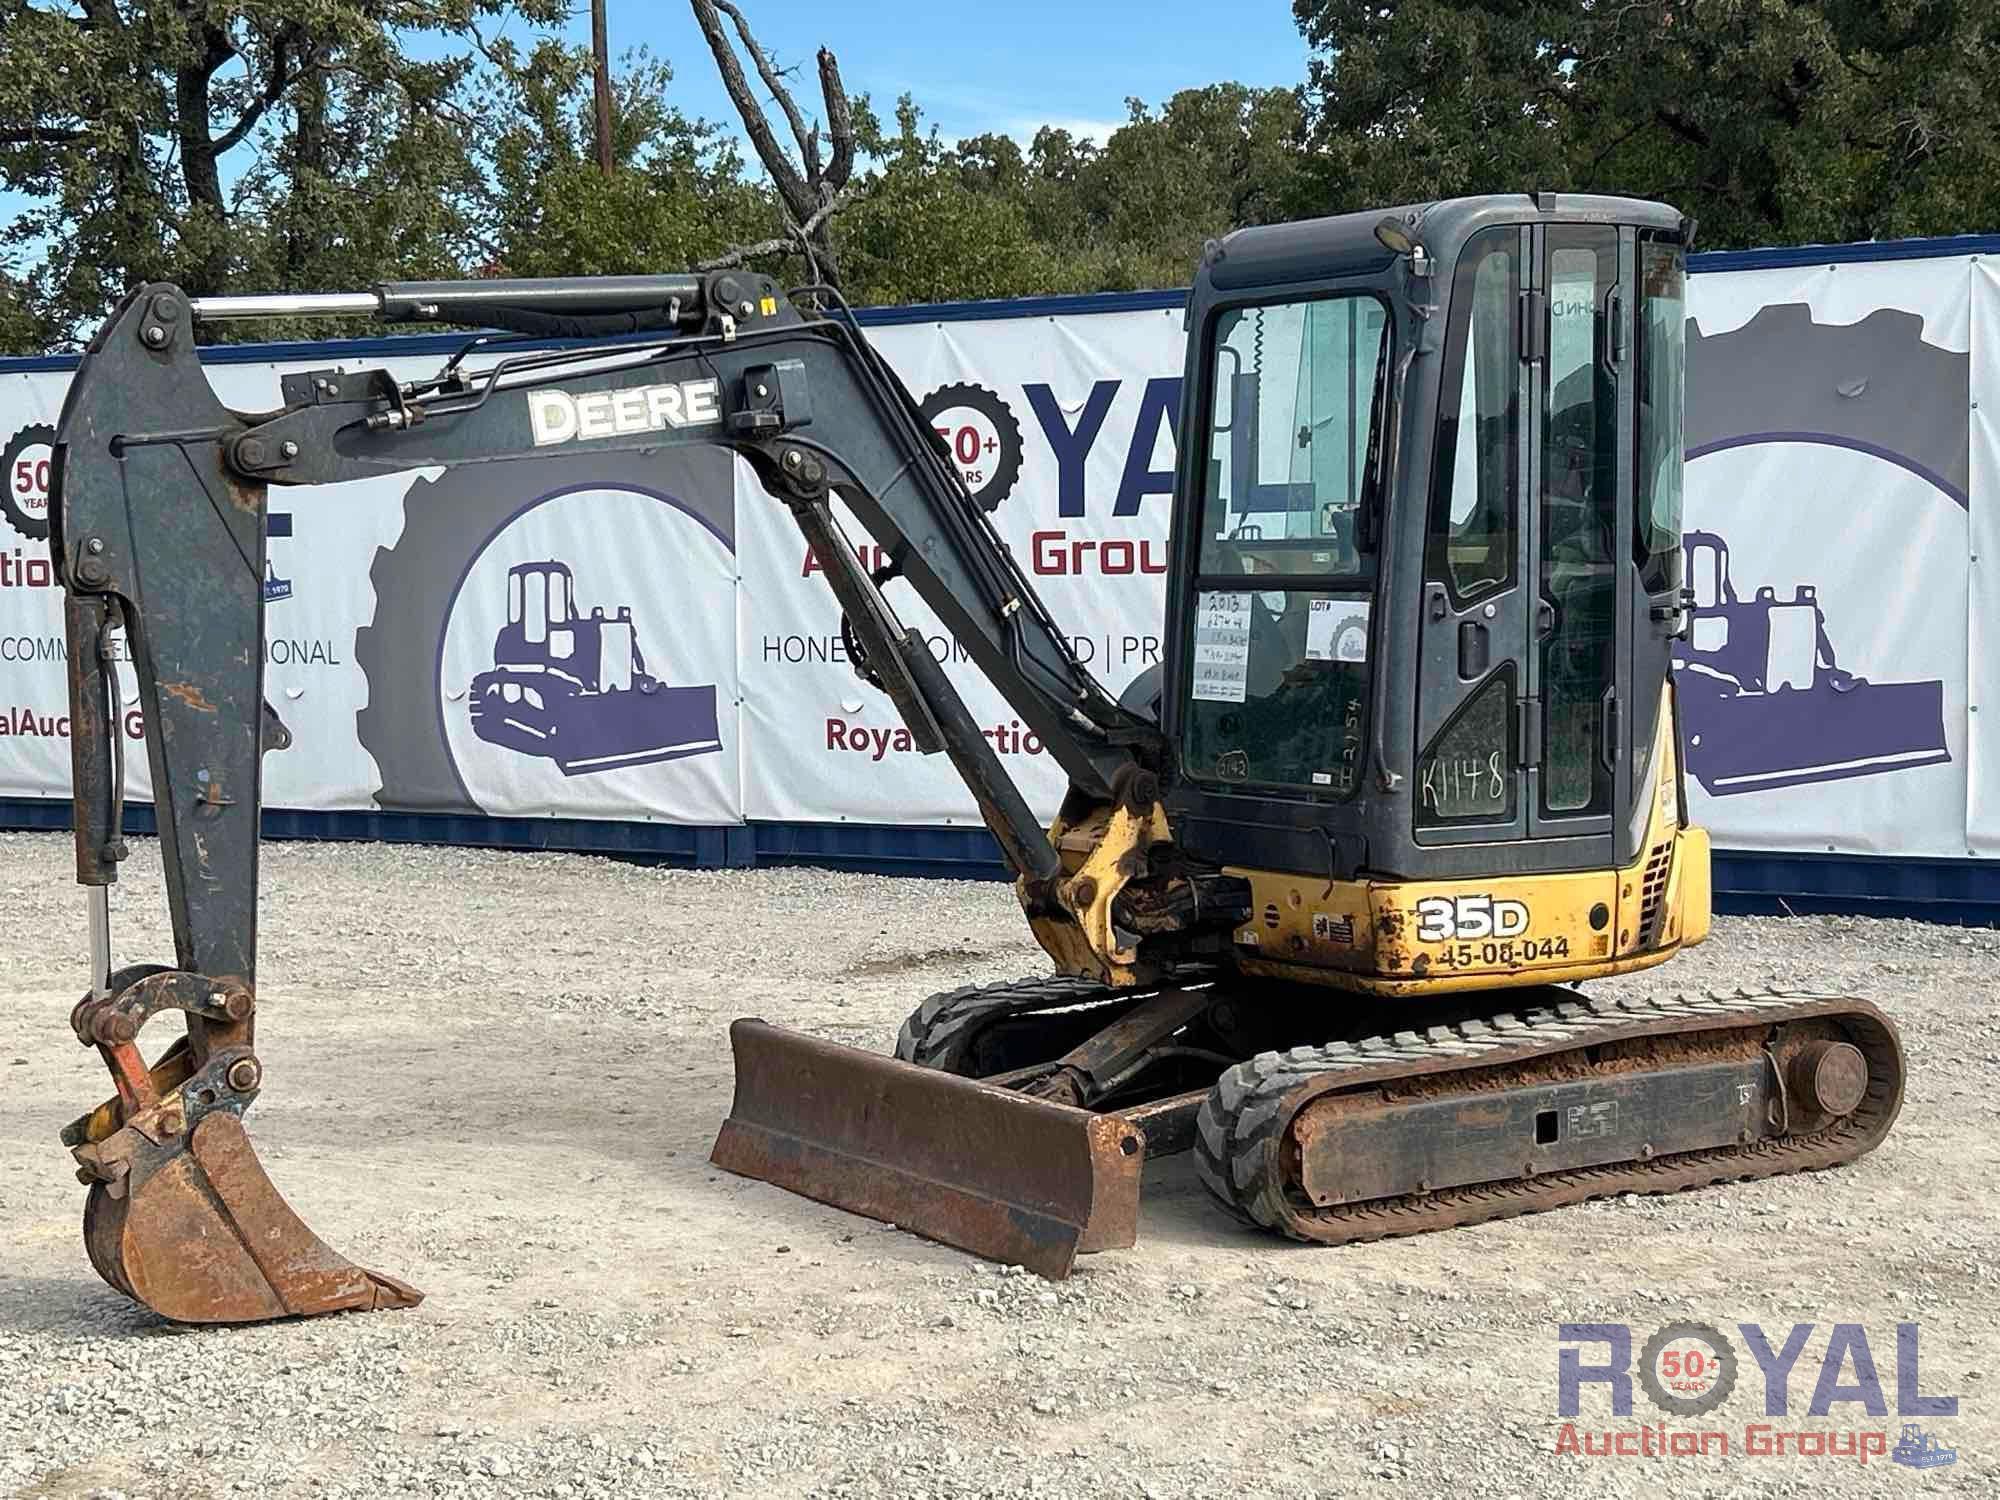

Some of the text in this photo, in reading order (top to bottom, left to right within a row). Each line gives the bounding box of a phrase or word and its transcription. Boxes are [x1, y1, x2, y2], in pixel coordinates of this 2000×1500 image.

[527, 378, 723, 447] DEERE
[1032, 530, 1169, 576] Grou
[763, 635, 846, 663] HONE
[1422, 750, 1504, 808] K1148
[1416, 893, 1530, 942] 35D
